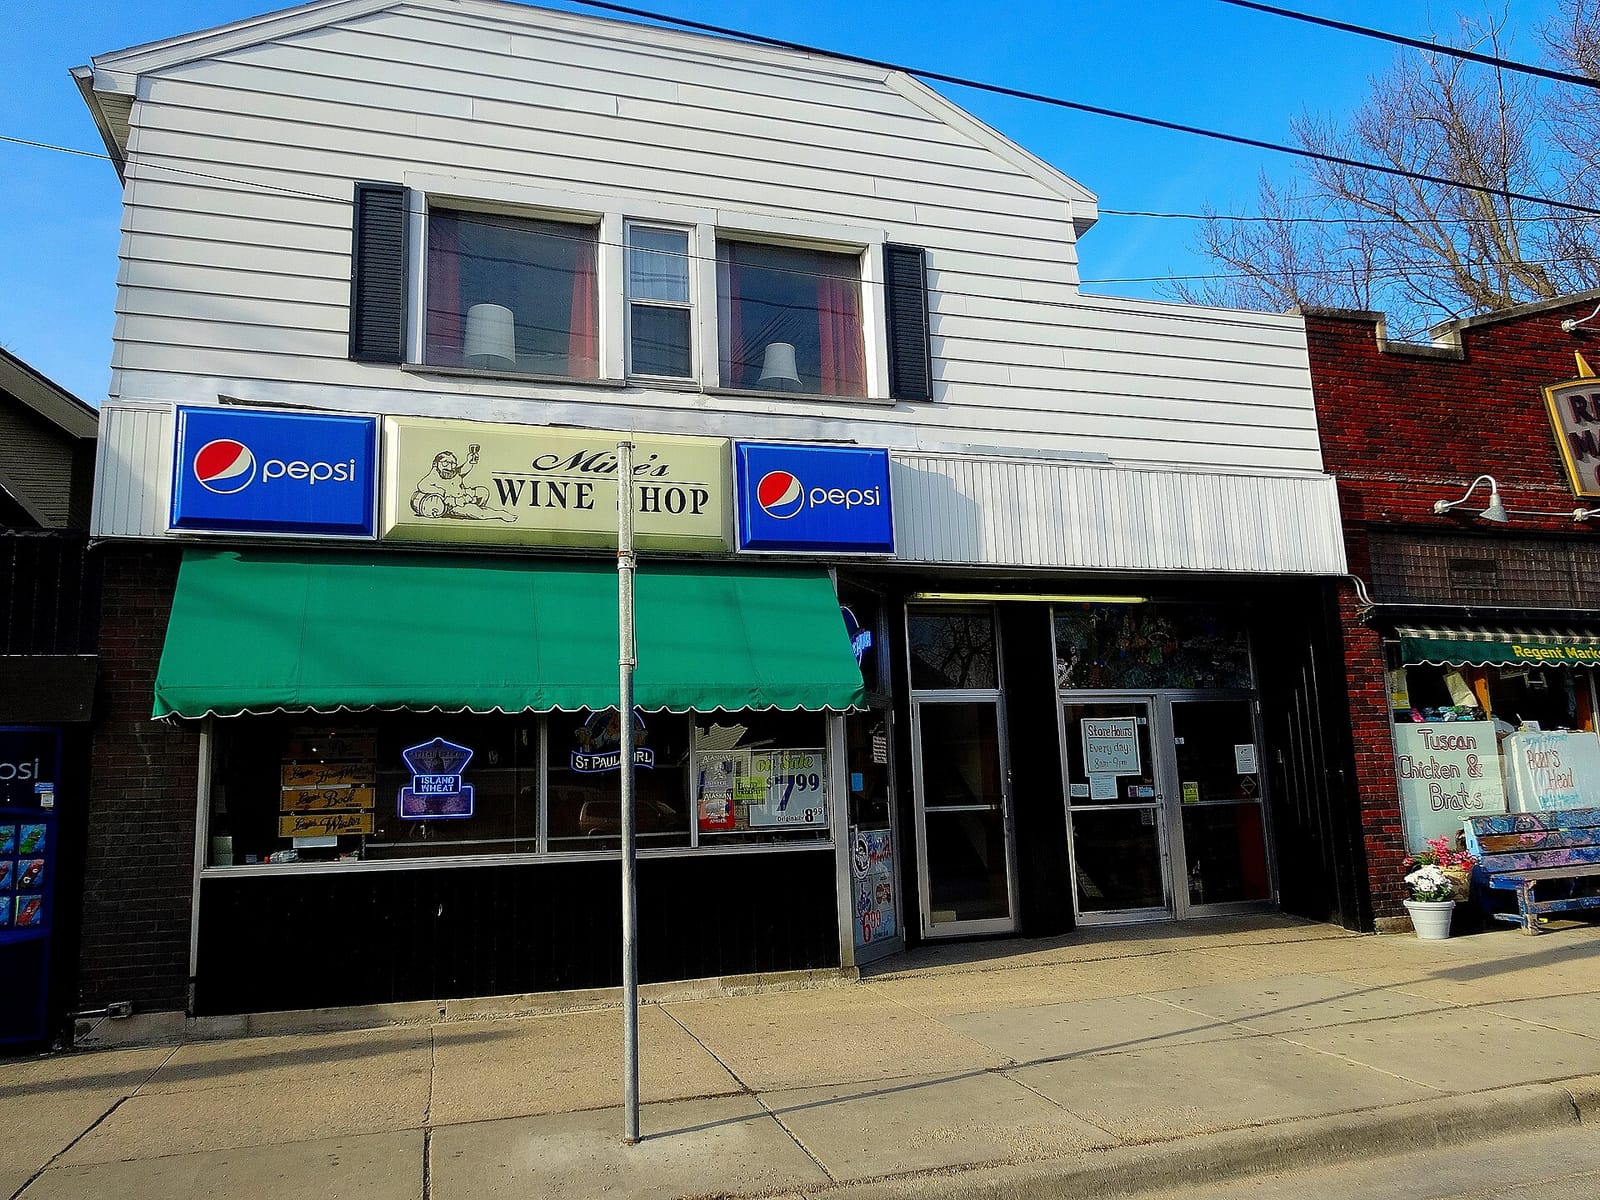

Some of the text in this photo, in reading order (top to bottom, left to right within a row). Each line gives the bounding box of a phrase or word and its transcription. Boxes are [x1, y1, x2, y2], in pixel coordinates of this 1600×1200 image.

[262, 457, 357, 486] pepsi
[532, 449, 670, 477] Mie's
[493, 478, 709, 515] WINE HOP
[809, 485, 880, 510] pepsi
[1512, 645, 1565, 661] Regent
[1088, 724, 1133, 737] Store Hours
[1417, 728, 1477, 751] Tuscan
[592, 754, 620, 769] PAUL
[633, 751, 652, 763] IRL
[1089, 743, 1112, 755] Every
[1398, 753, 1483, 780] Chicken &
[420, 784, 454, 792] WHEAT
[421, 776, 455, 785] ISLAND
[1429, 783, 1484, 811] Brats
